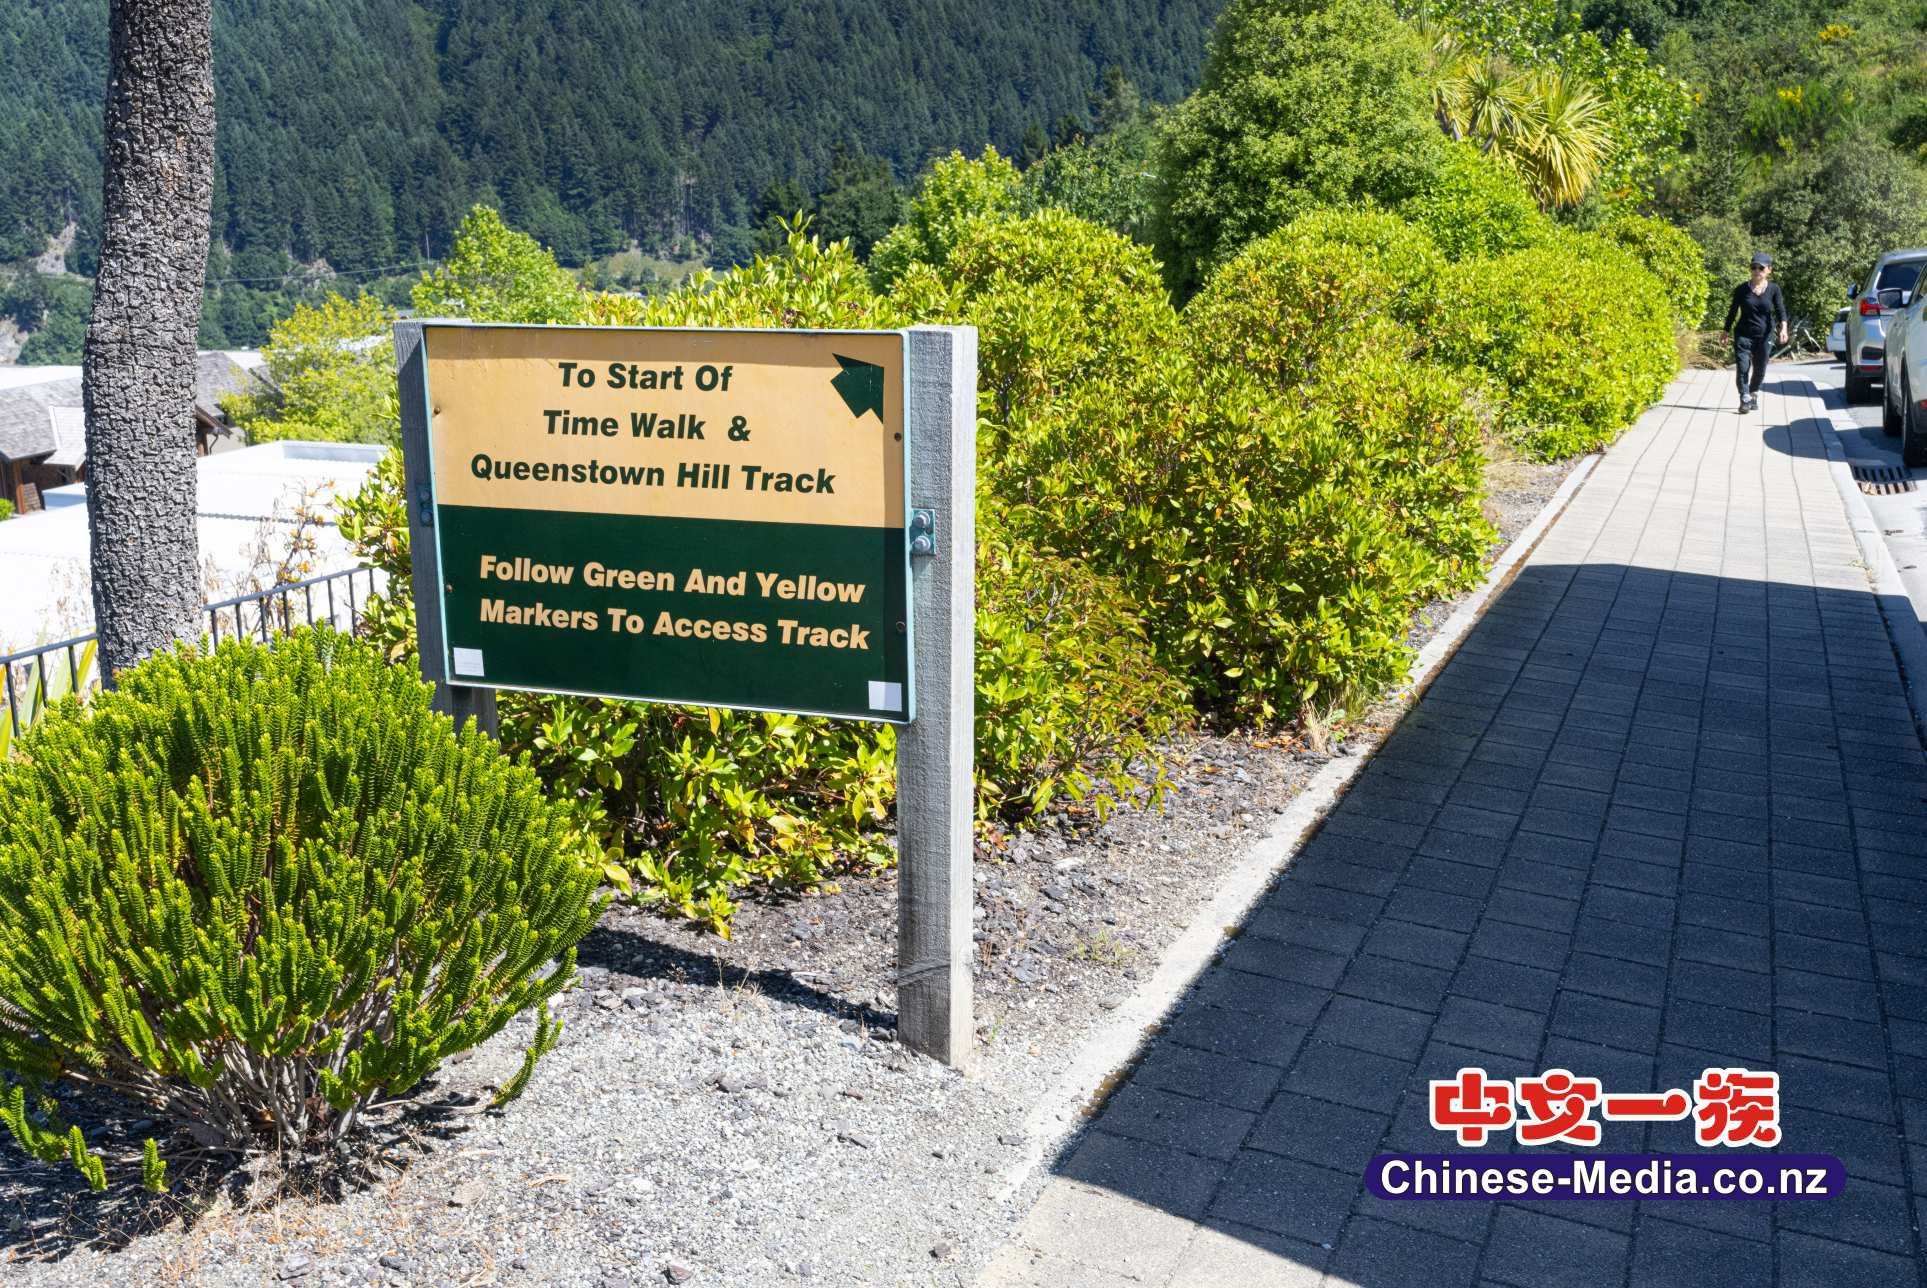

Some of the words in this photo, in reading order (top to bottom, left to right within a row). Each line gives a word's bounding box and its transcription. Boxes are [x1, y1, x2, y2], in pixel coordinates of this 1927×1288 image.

[559, 362, 595, 388] To
[606, 362, 684, 390] Start
[695, 365, 733, 391] Of
[544, 410, 618, 437] Time
[631, 413, 705, 439] Walk
[728, 416, 750, 441] &
[471, 454, 664, 486] Queenstown
[677, 463, 730, 489] Hill
[741, 466, 835, 493] Track
[481, 555, 574, 584] Follow
[584, 562, 674, 591] Green
[684, 569, 746, 595] And
[756, 572, 865, 603] Yellow
[481, 599, 598, 630] Markers
[608, 608, 644, 633] To
[653, 612, 767, 642] Access
[778, 620, 870, 649] Track
